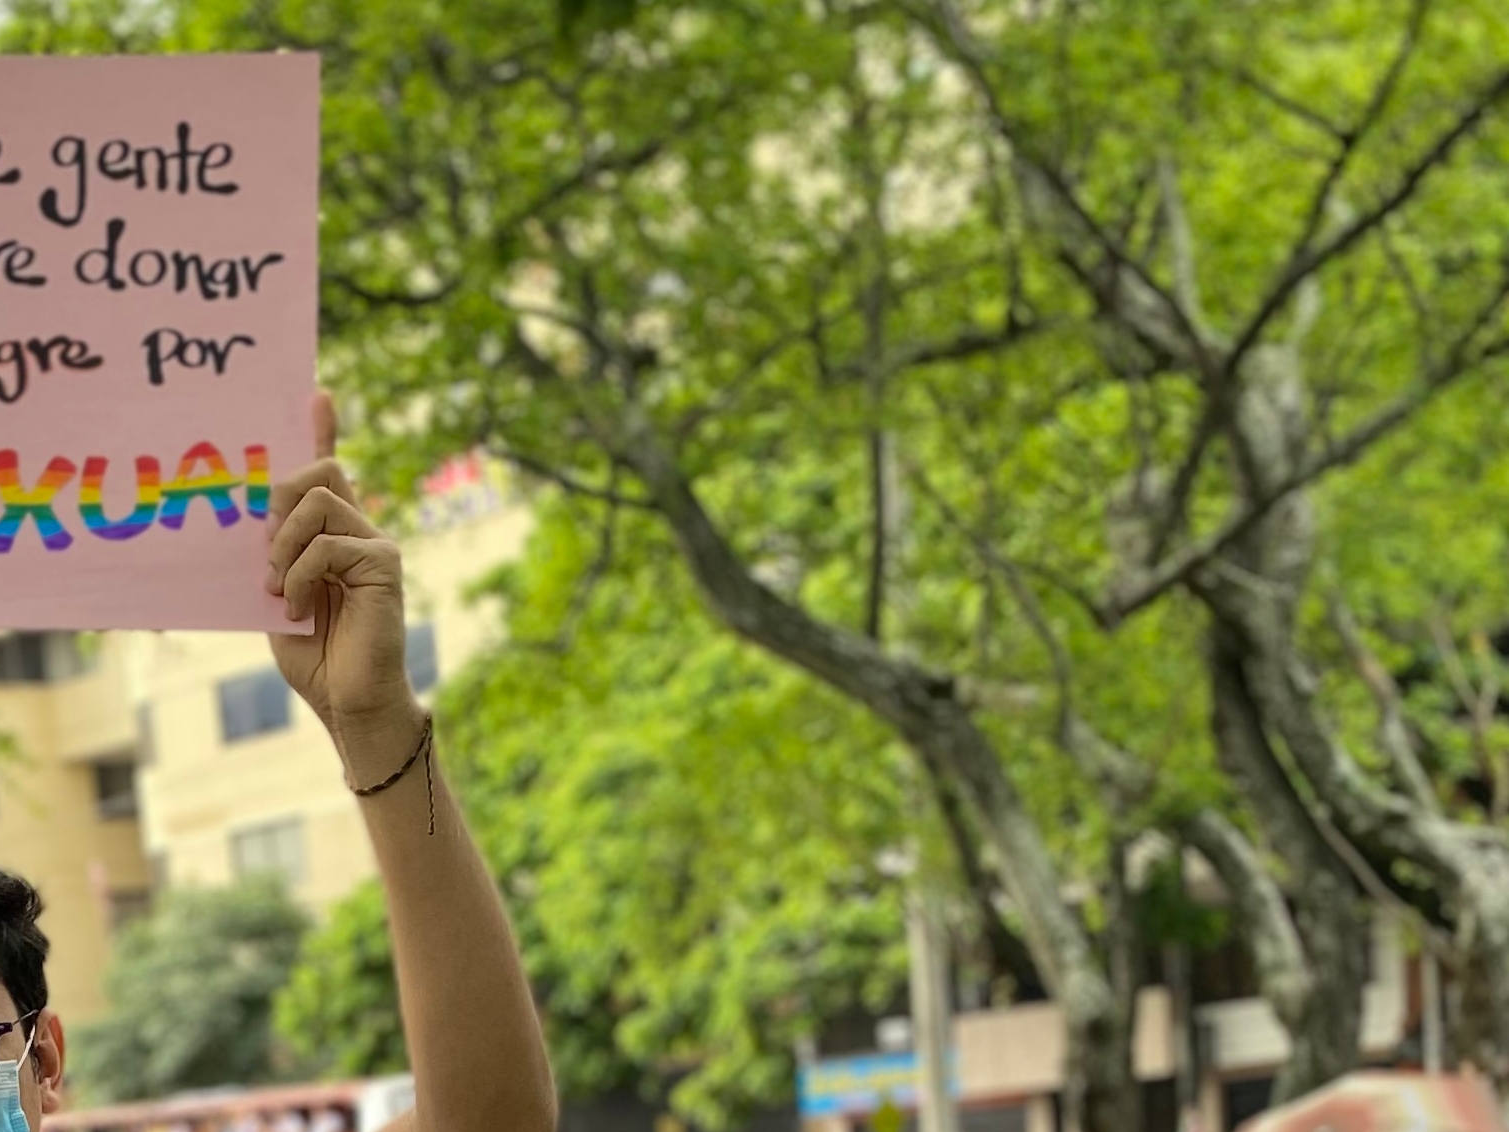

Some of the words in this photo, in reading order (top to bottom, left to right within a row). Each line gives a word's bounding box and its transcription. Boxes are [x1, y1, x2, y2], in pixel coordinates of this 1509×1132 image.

[39, 121, 240, 228] gente
[75, 218, 285, 301] donar
[141, 327, 256, 386] por
